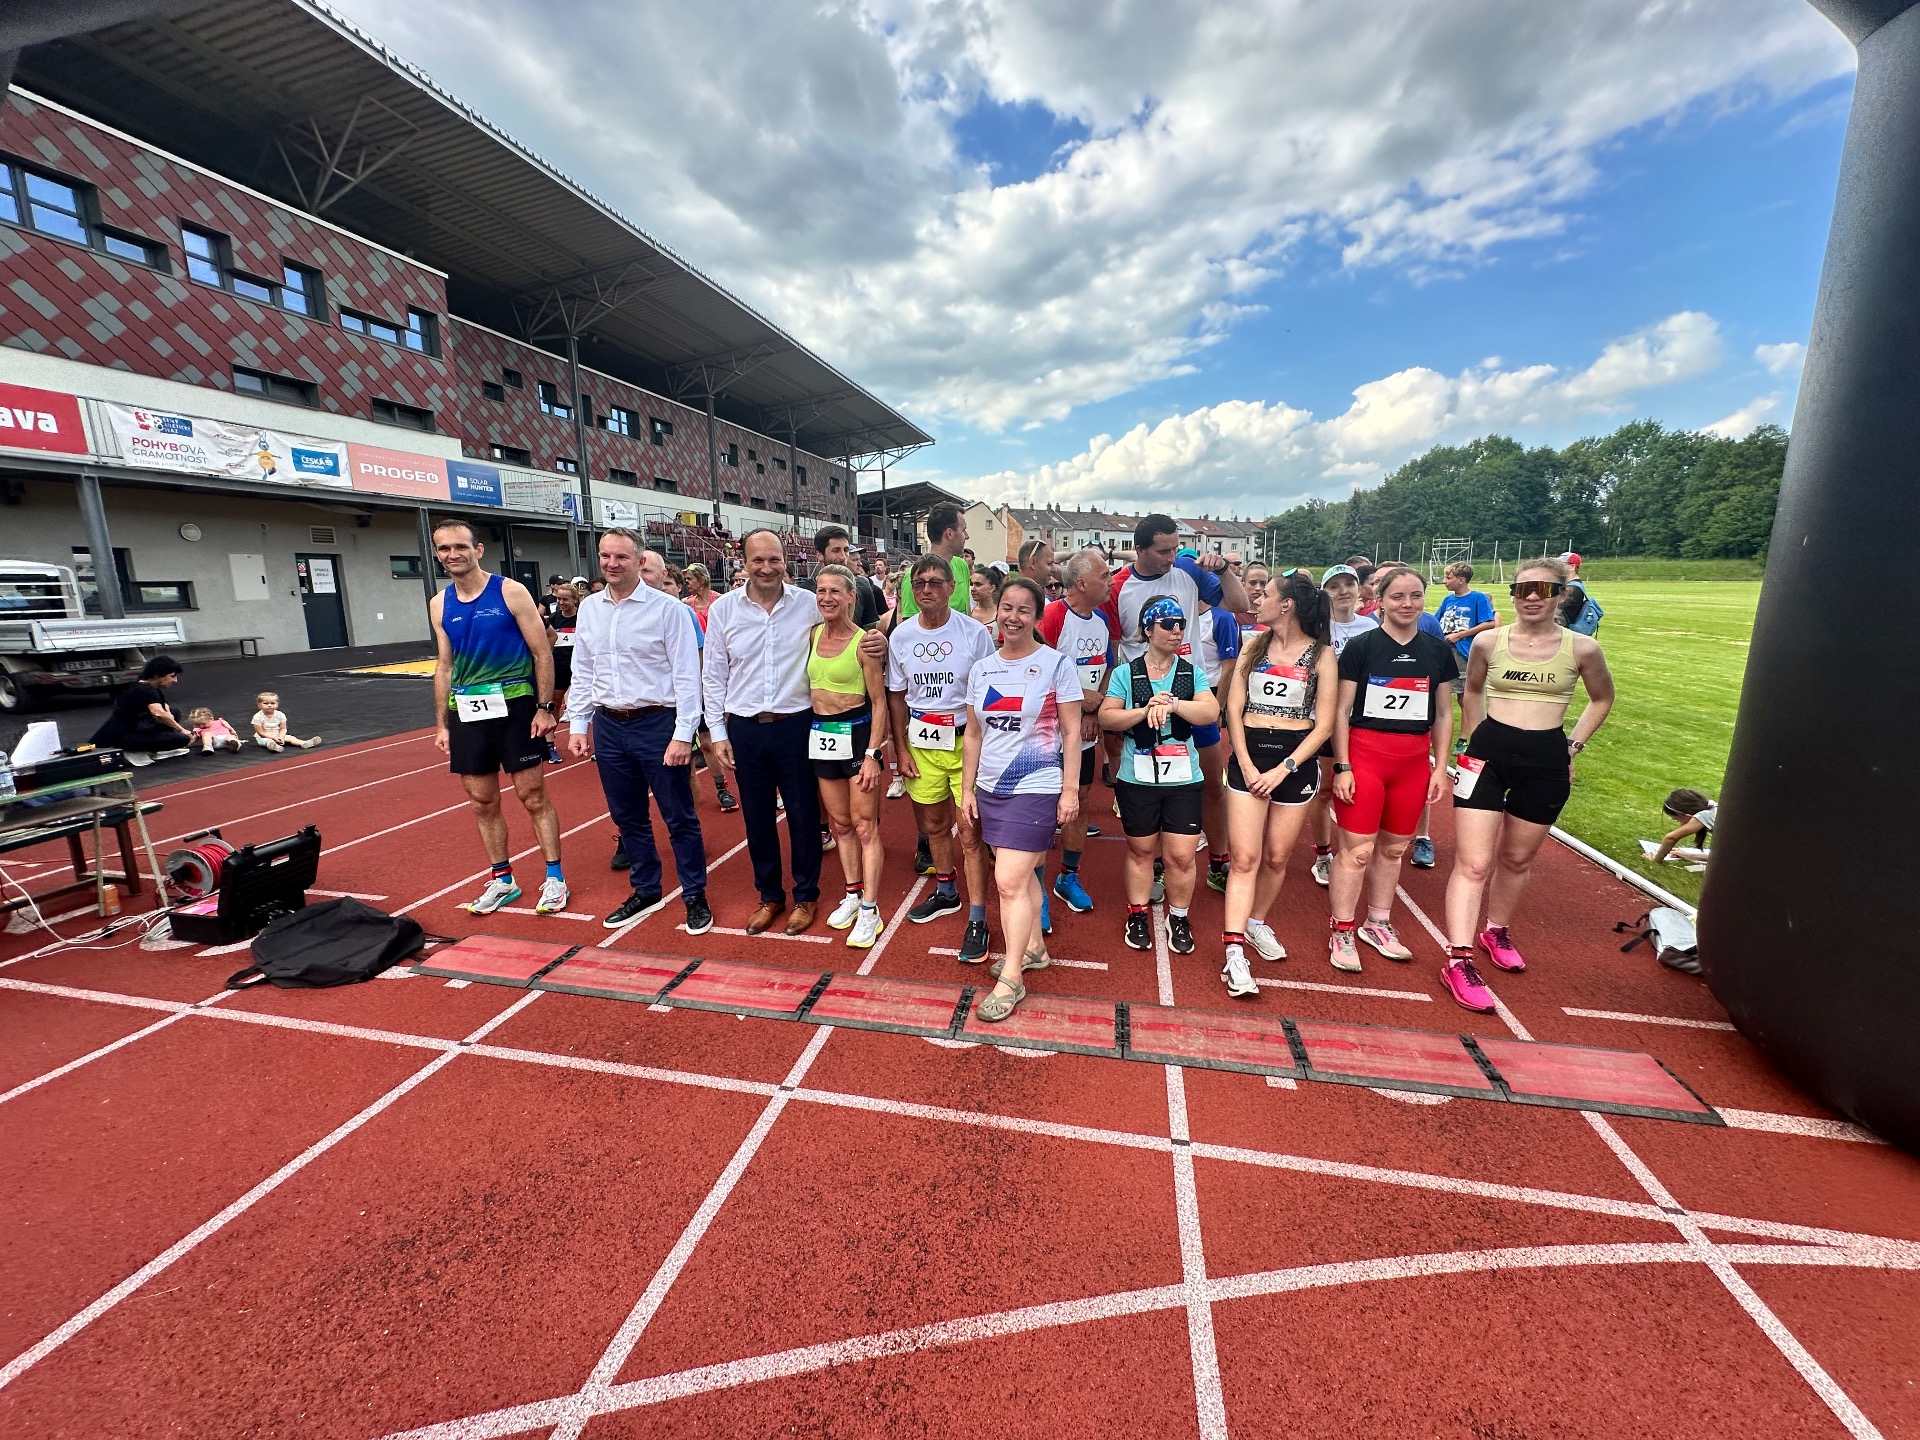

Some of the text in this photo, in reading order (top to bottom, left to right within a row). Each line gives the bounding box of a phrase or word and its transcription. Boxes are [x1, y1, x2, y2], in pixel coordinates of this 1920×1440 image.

[132, 437, 207, 456] POHYBOVÁ
[132, 448, 208, 465] GRAMOTNOST
[301, 454, 326, 467] ČESKÁ
[359, 462, 439, 484] PROGEO
[470, 477, 488, 486] SOLAR
[470, 484, 494, 493] HUNTER
[913, 671, 954, 685] OLYMPIC
[926, 686, 943, 699] DAY
[1263, 680, 1288, 698] 62
[469, 699, 489, 713] 31
[1383, 694, 1410, 710] 27
[985, 715, 1022, 733] CZE
[918, 727, 941, 742] 44
[819, 737, 837, 752] 32
